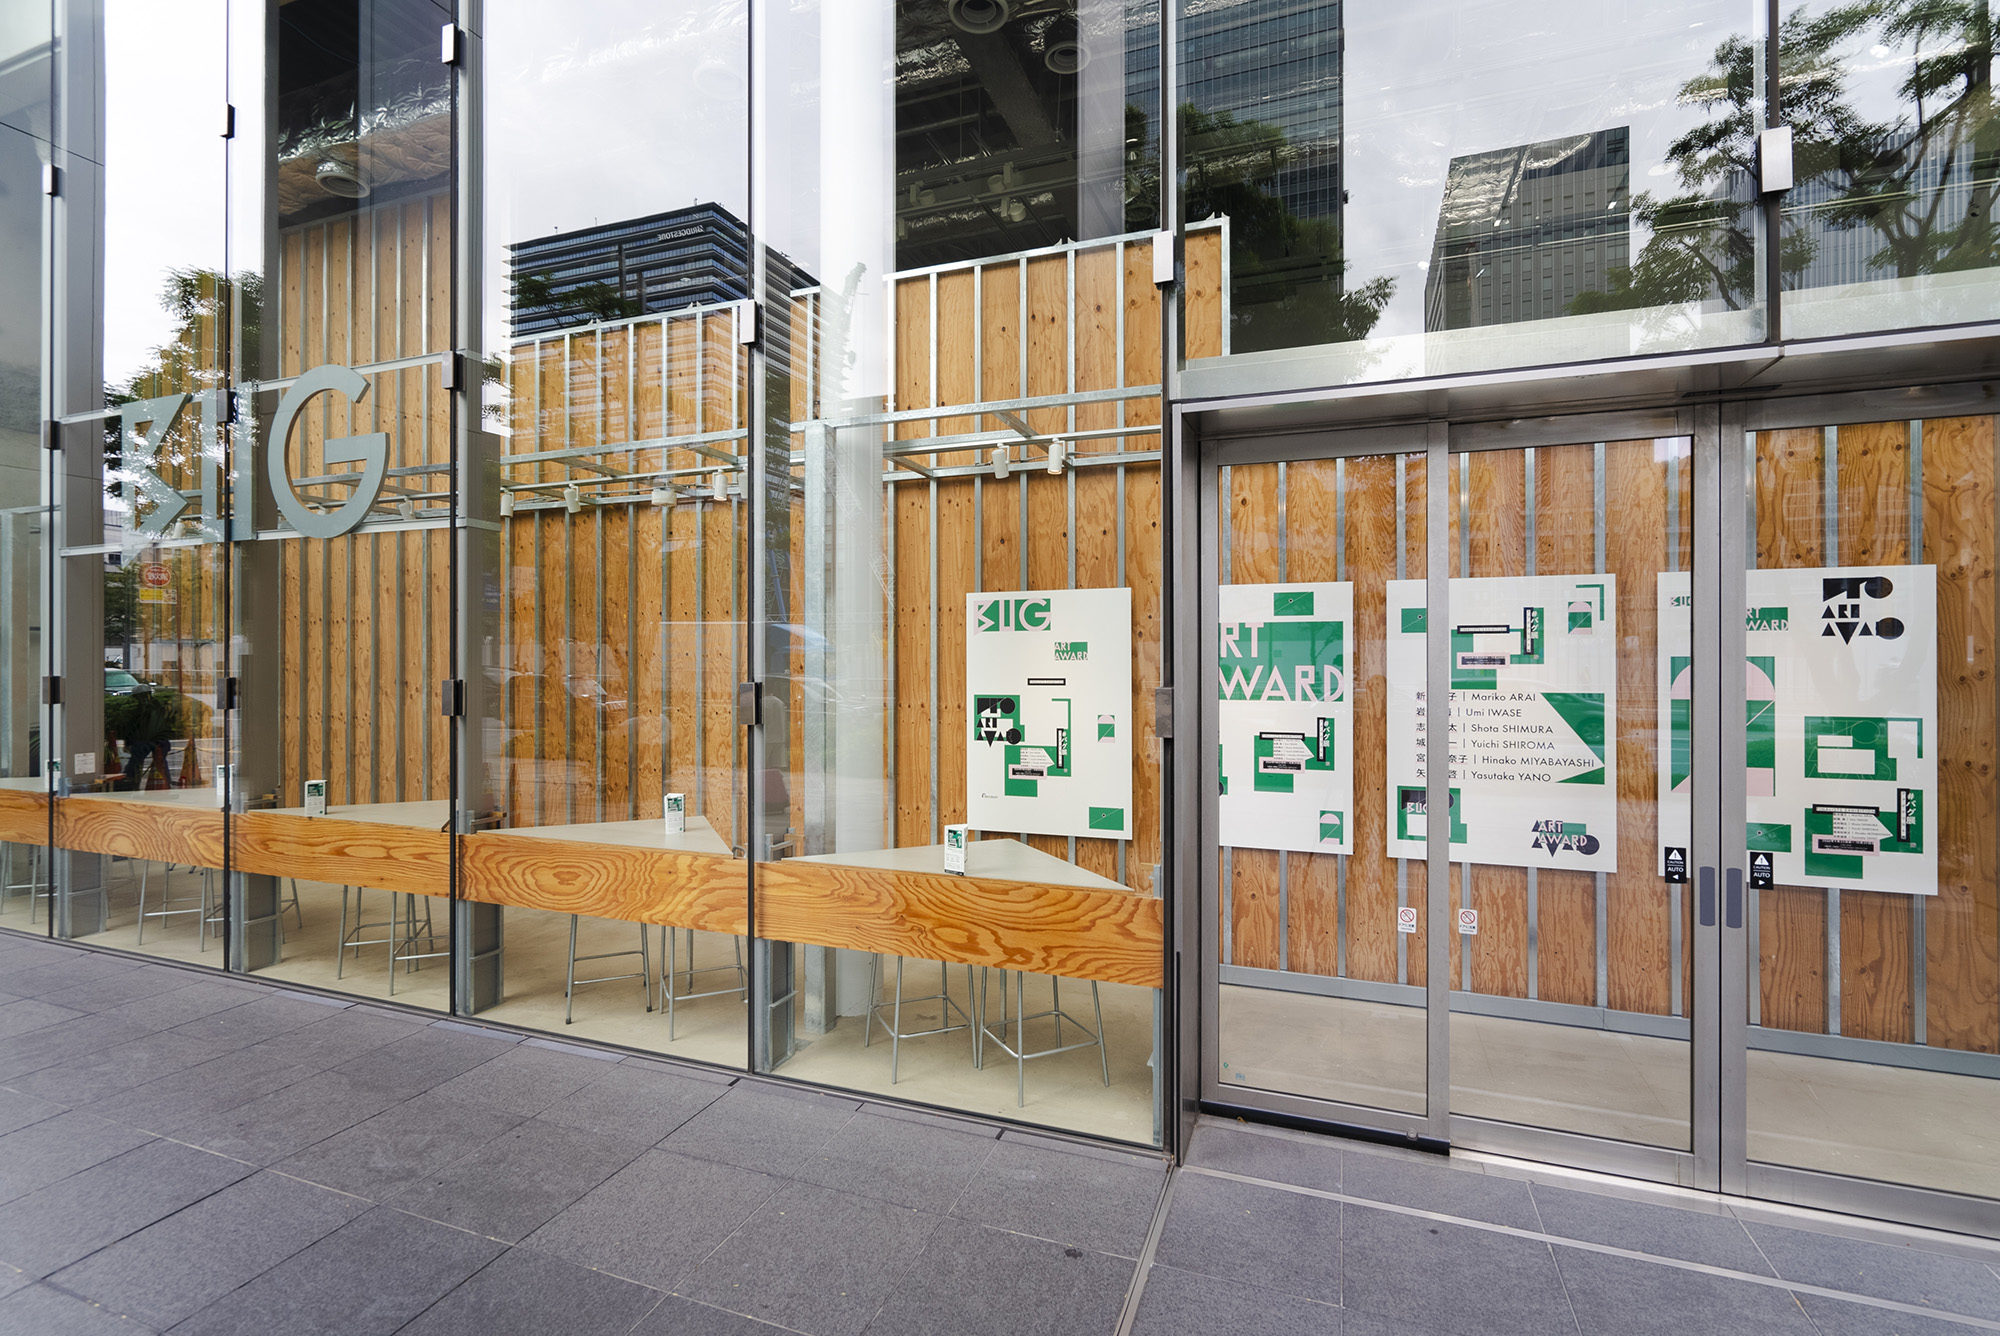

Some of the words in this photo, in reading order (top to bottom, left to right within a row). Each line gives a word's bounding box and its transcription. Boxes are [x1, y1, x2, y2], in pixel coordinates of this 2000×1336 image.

[121, 364, 390, 567] BUG
[973, 597, 1051, 636] BUG
[1220, 622, 1264, 658] RT
[1054, 642, 1071, 651] ART
[1054, 652, 1089, 661] AWARD
[1219, 664, 1345, 702] WARD
[1471, 692, 1506, 701] Mariko
[1509, 693, 1536, 701] ARAI
[1465, 708, 1484, 716] Umi
[1488, 709, 1522, 717] IWASE
[1471, 724, 1499, 733] Shota
[1502, 725, 1554, 734] SHIMURA
[1471, 739, 1499, 748] Yuichi
[1503, 741, 1555, 750] SHIROMA
[1482, 755, 1517, 765] Hinako
[1520, 758, 1595, 767] MIYABAYASHI
[1471, 771, 1515, 781] Yasutaka
[1518, 773, 1551, 782] YANO
[1538, 821, 1563, 833] ART
[1538, 833, 1588, 847] AWARD
